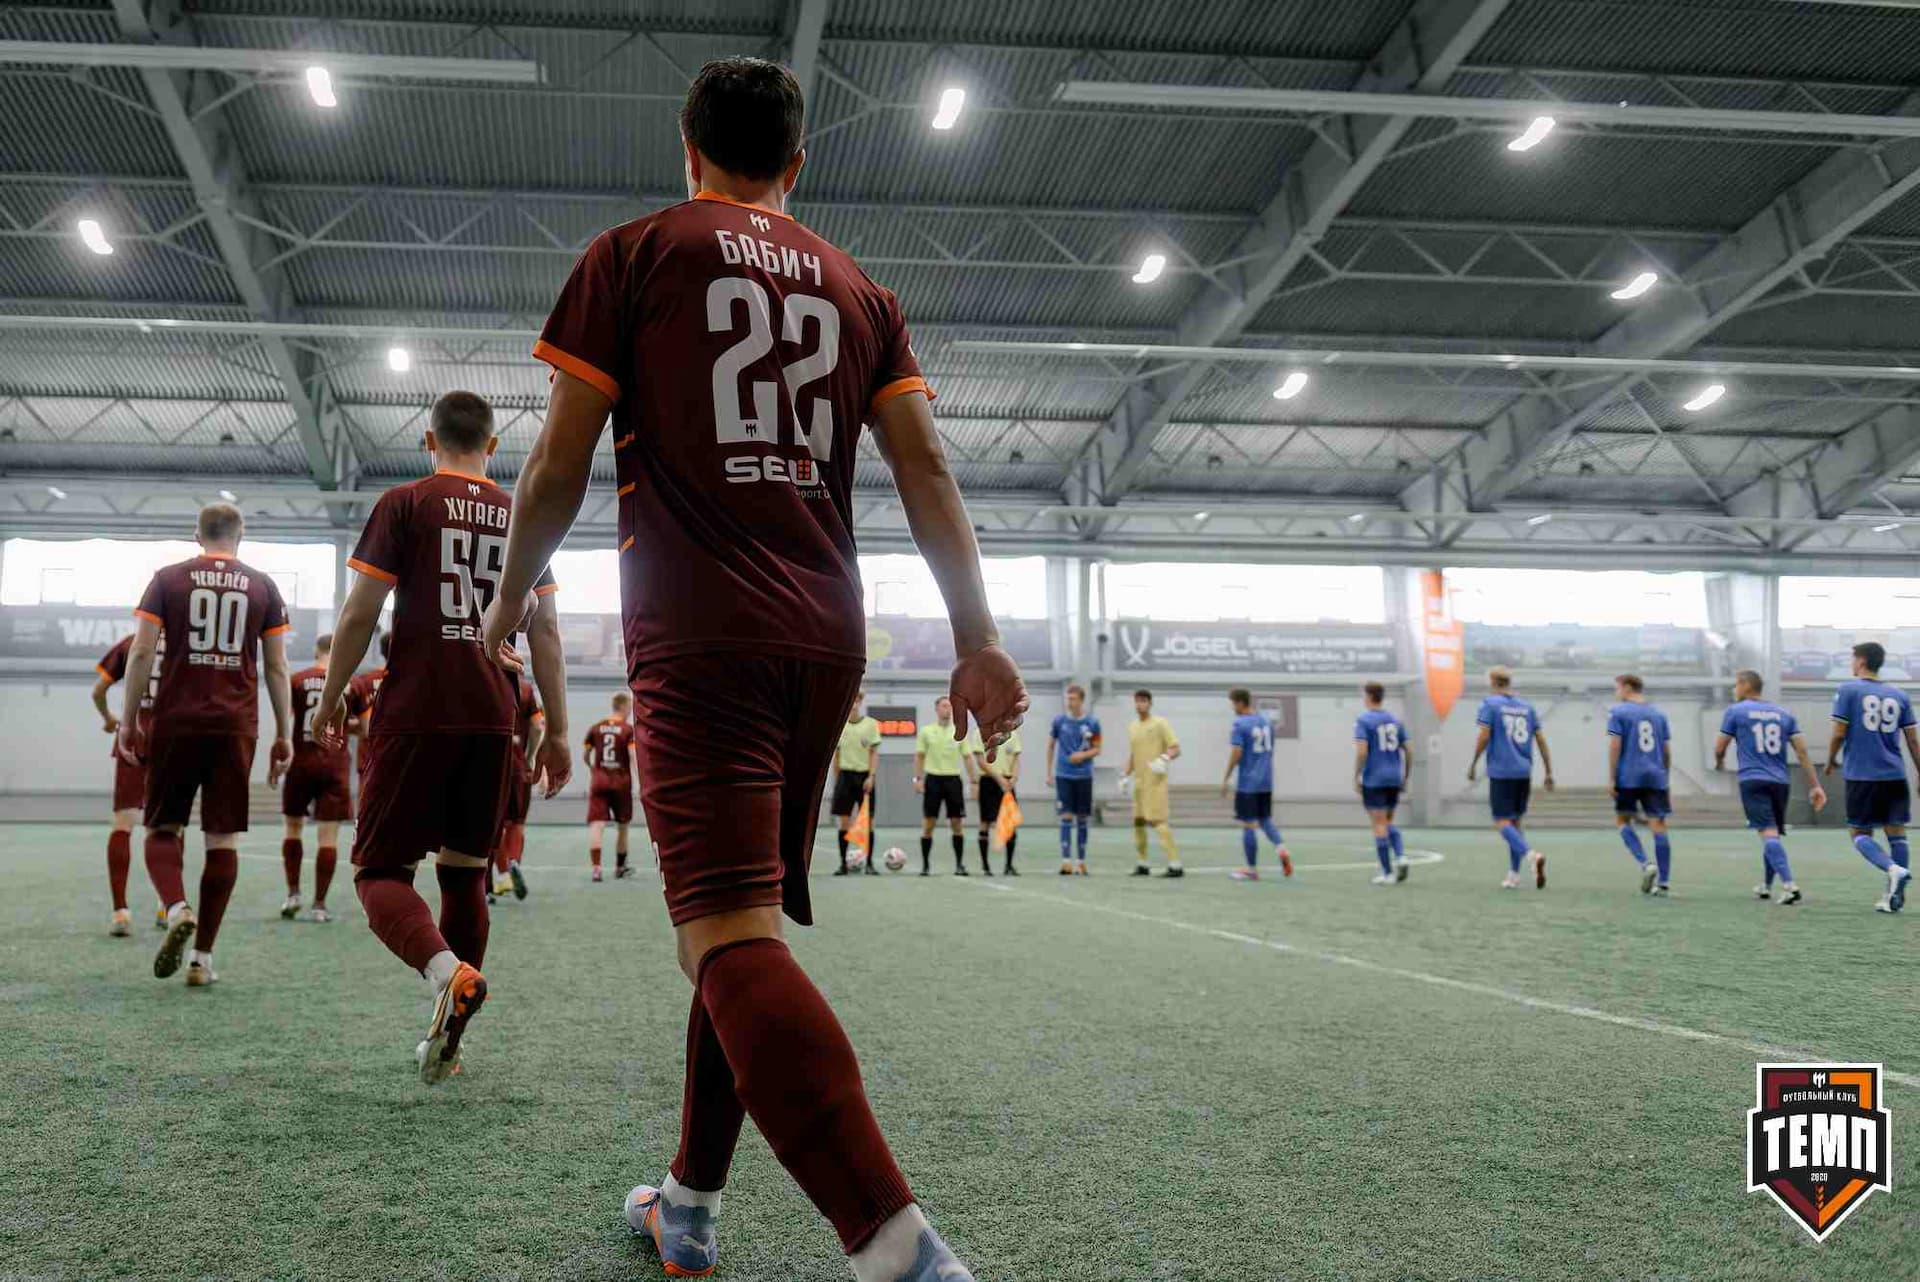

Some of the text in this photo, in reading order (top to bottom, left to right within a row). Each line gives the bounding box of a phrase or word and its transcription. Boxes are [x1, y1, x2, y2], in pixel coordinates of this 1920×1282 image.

[715, 229, 822, 287] БАБИЧ
[706, 277, 840, 462] 22
[724, 455, 826, 486] SEU
[444, 497, 508, 529] ХУГАЕВ
[440, 527, 509, 619] 55
[189, 588, 249, 654] 90
[188, 653, 242, 666] SEUS
[1503, 714, 1529, 744] 78
[1862, 695, 1901, 733] 89
[603, 733, 616, 761] 2
[1252, 725, 1272, 753] 21
[1377, 723, 1399, 752] 13
[1638, 720, 1655, 752] 8
[1752, 721, 1782, 754] 18
